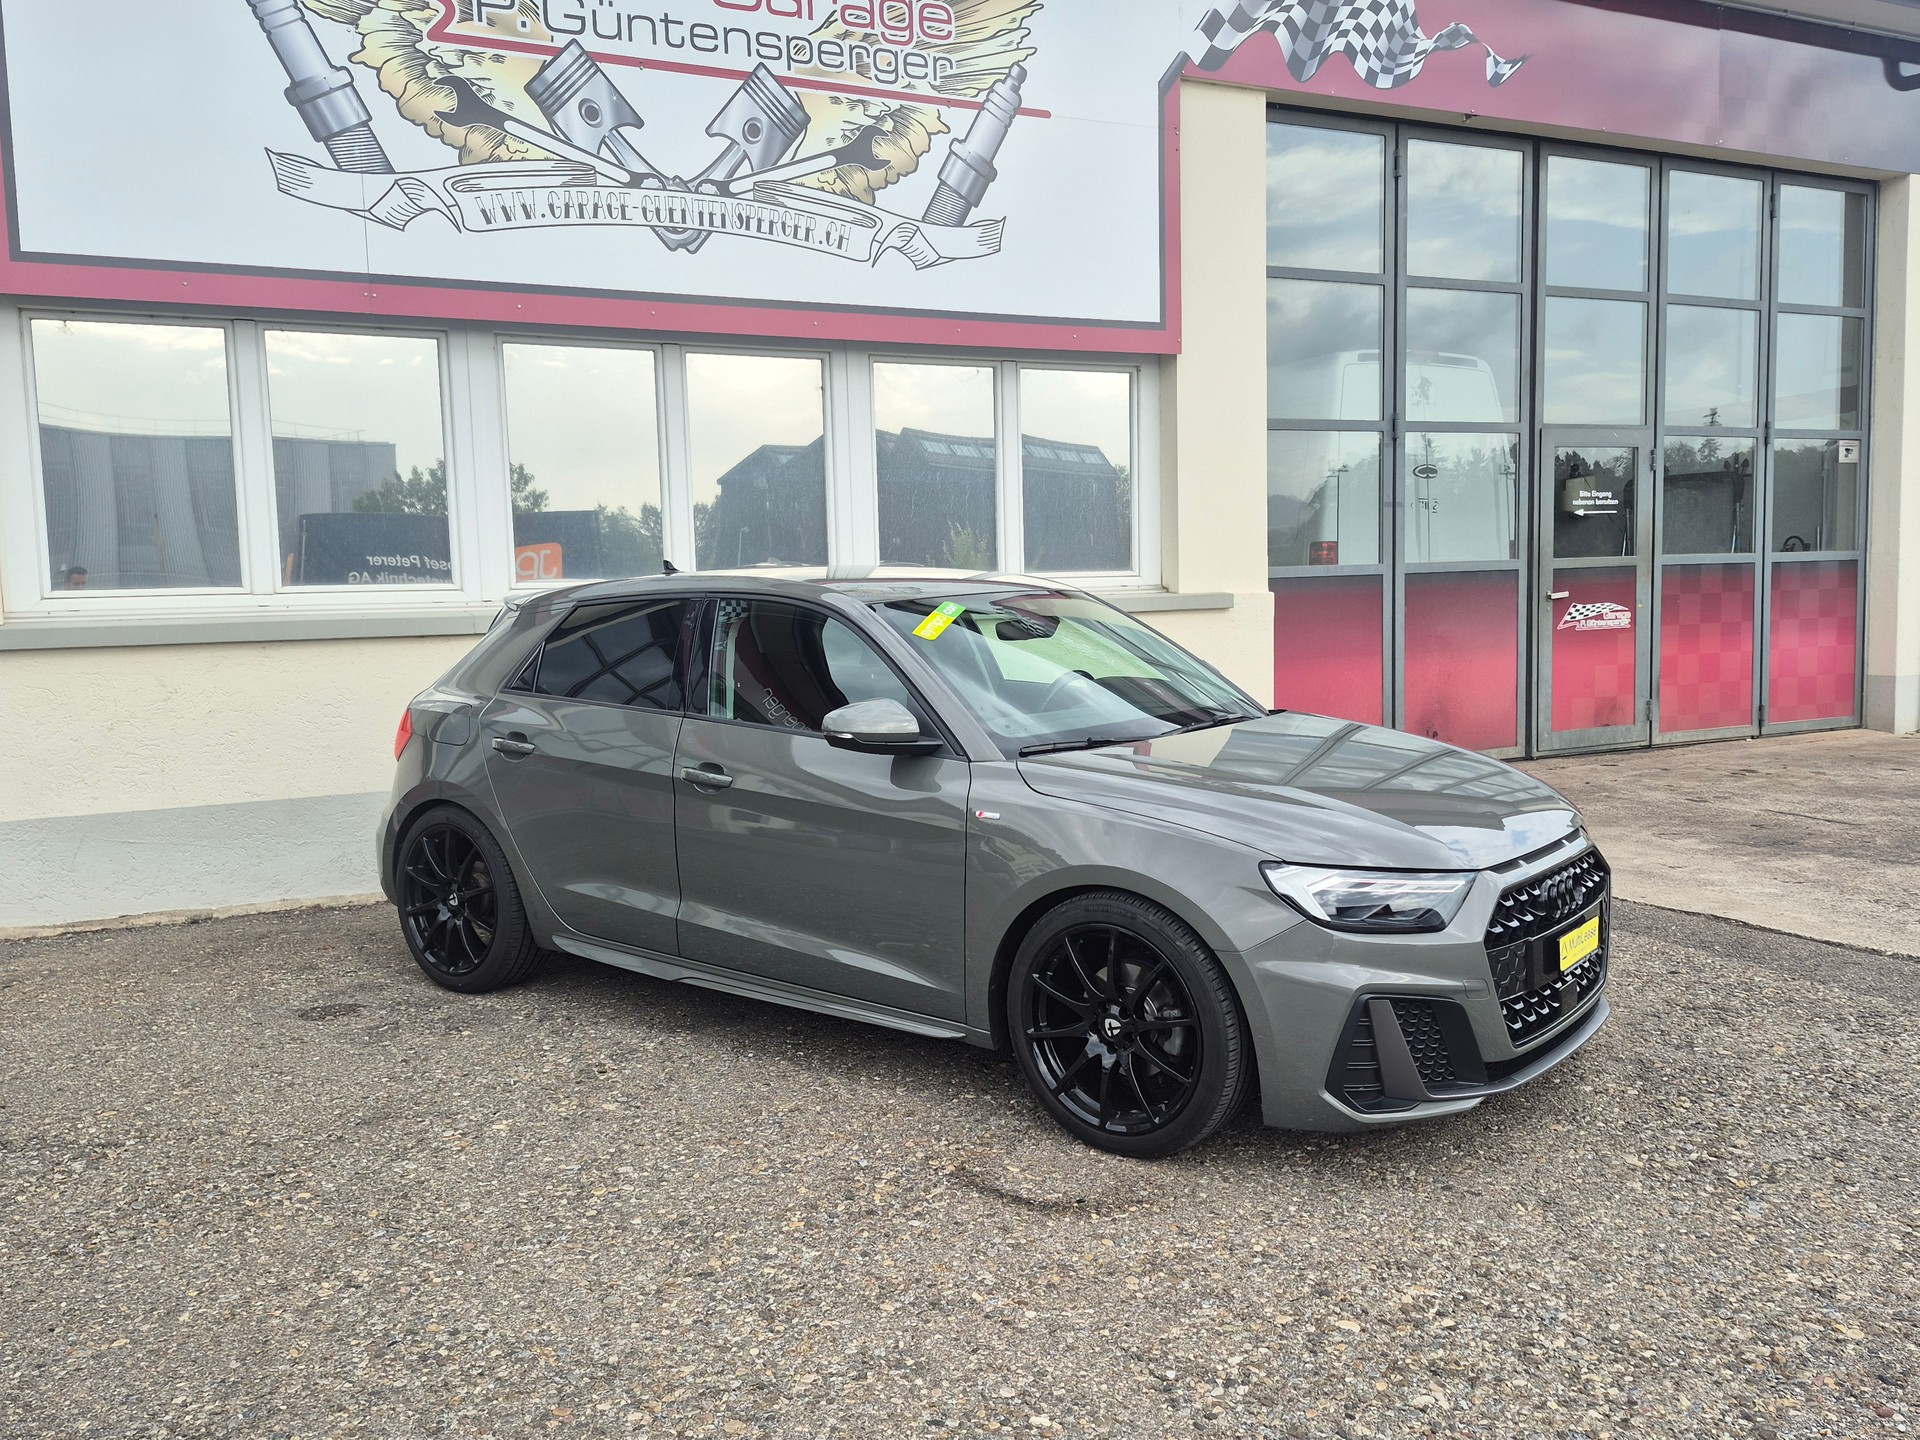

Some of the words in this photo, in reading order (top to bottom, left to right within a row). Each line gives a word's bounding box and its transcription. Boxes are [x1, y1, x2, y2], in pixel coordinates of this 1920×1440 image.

[543, 0, 954, 85] Güntensperger
[713, 0, 953, 47] arage
[474, 189, 852, 252] WWW.GARAGE-GUENTENSPERGER.CH
